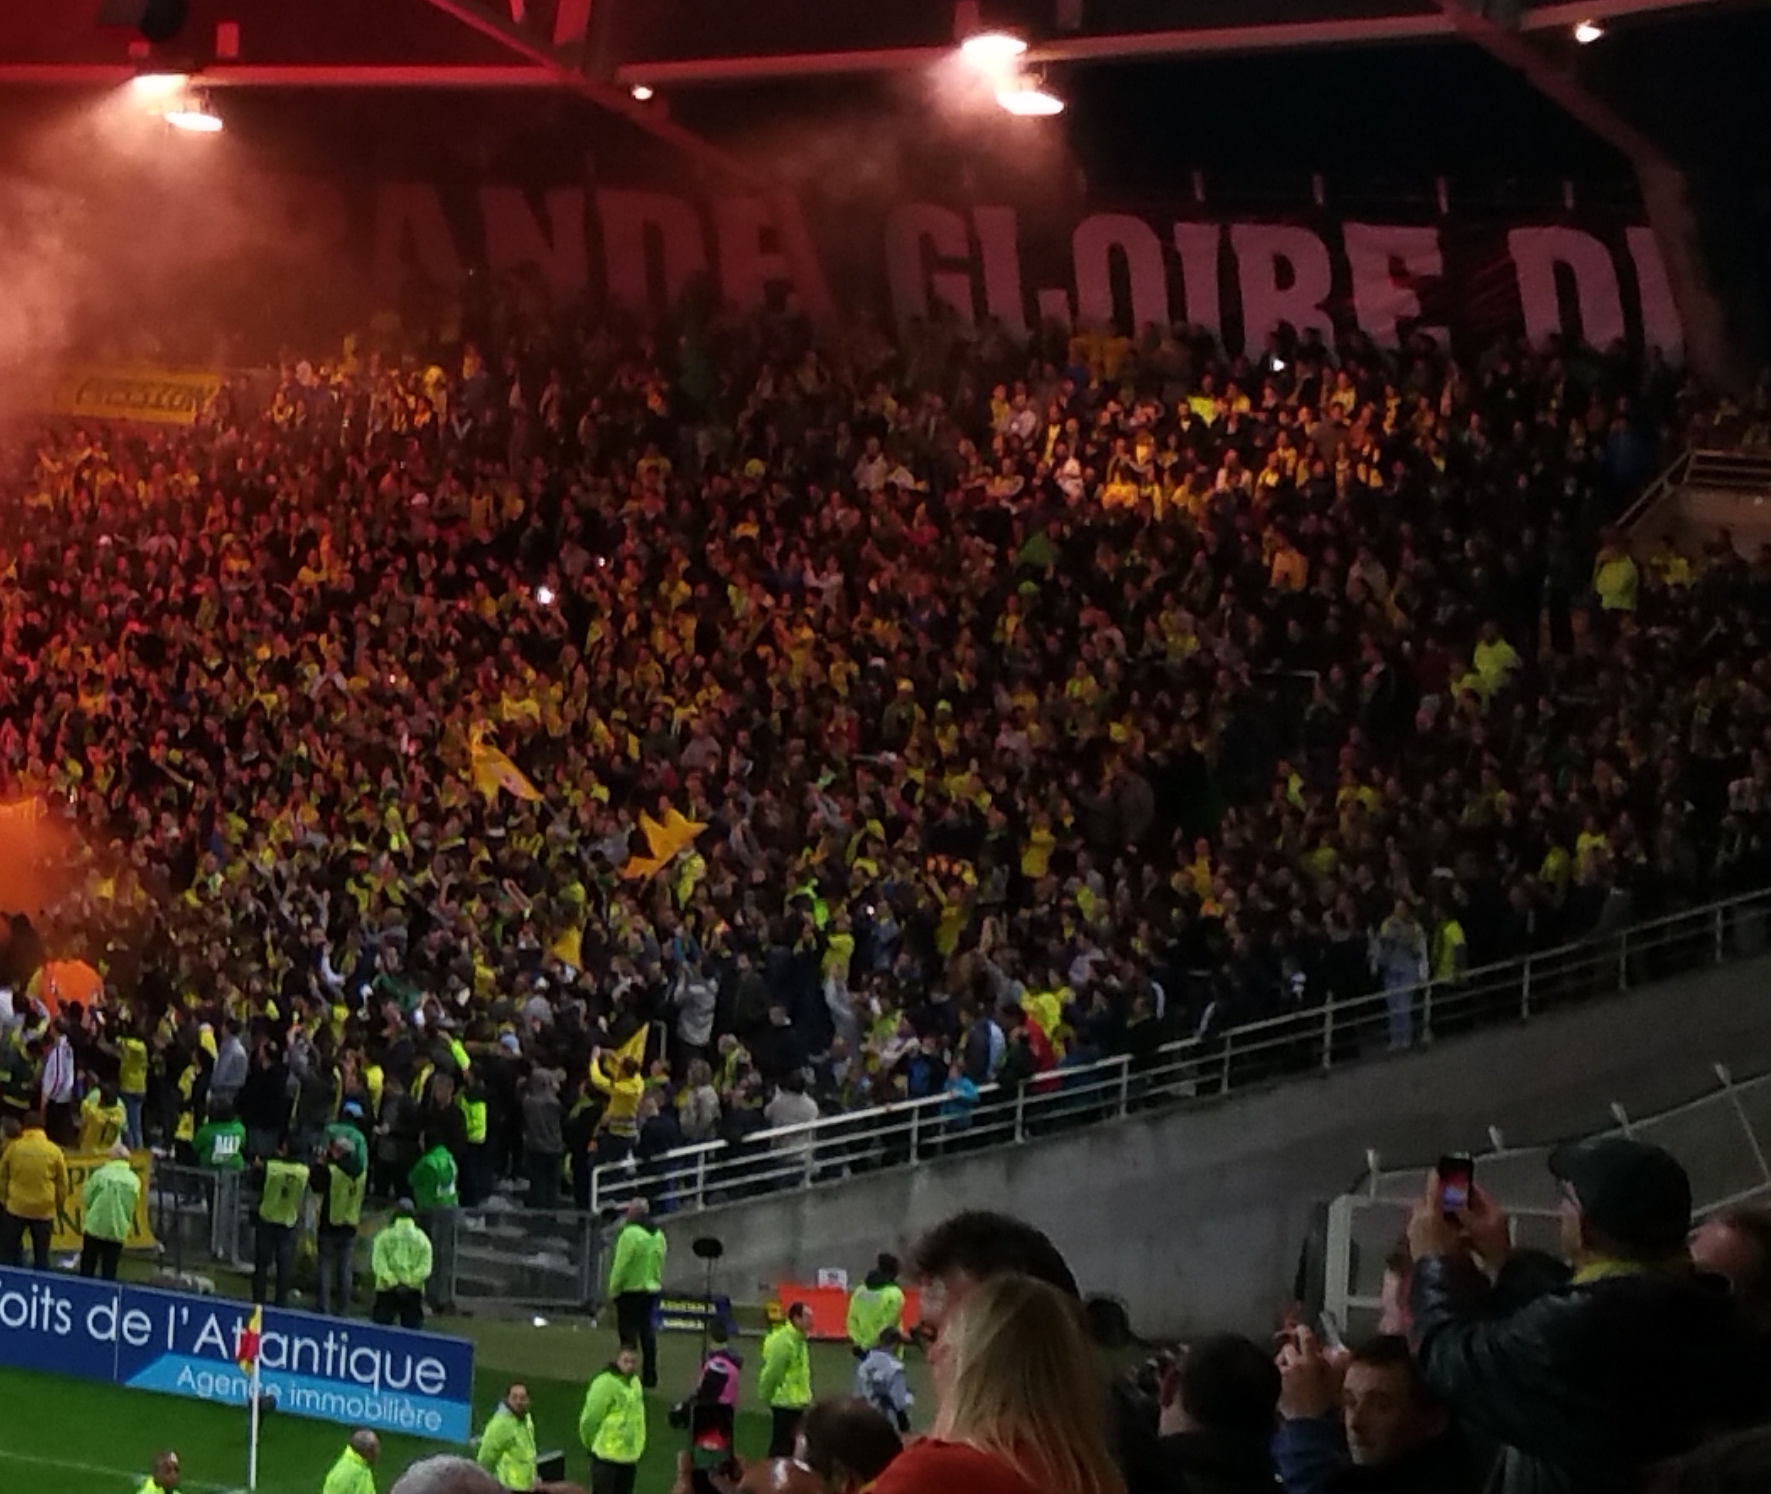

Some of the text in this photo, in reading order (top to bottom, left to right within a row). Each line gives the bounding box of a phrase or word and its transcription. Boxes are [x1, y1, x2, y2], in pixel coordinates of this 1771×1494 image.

[885, 203, 1451, 363] GLOIRE
[87, 1296, 152, 1346] de
[167, 1304, 447, 1395] l'Atantique
[290, 1382, 443, 1432] immobilière
